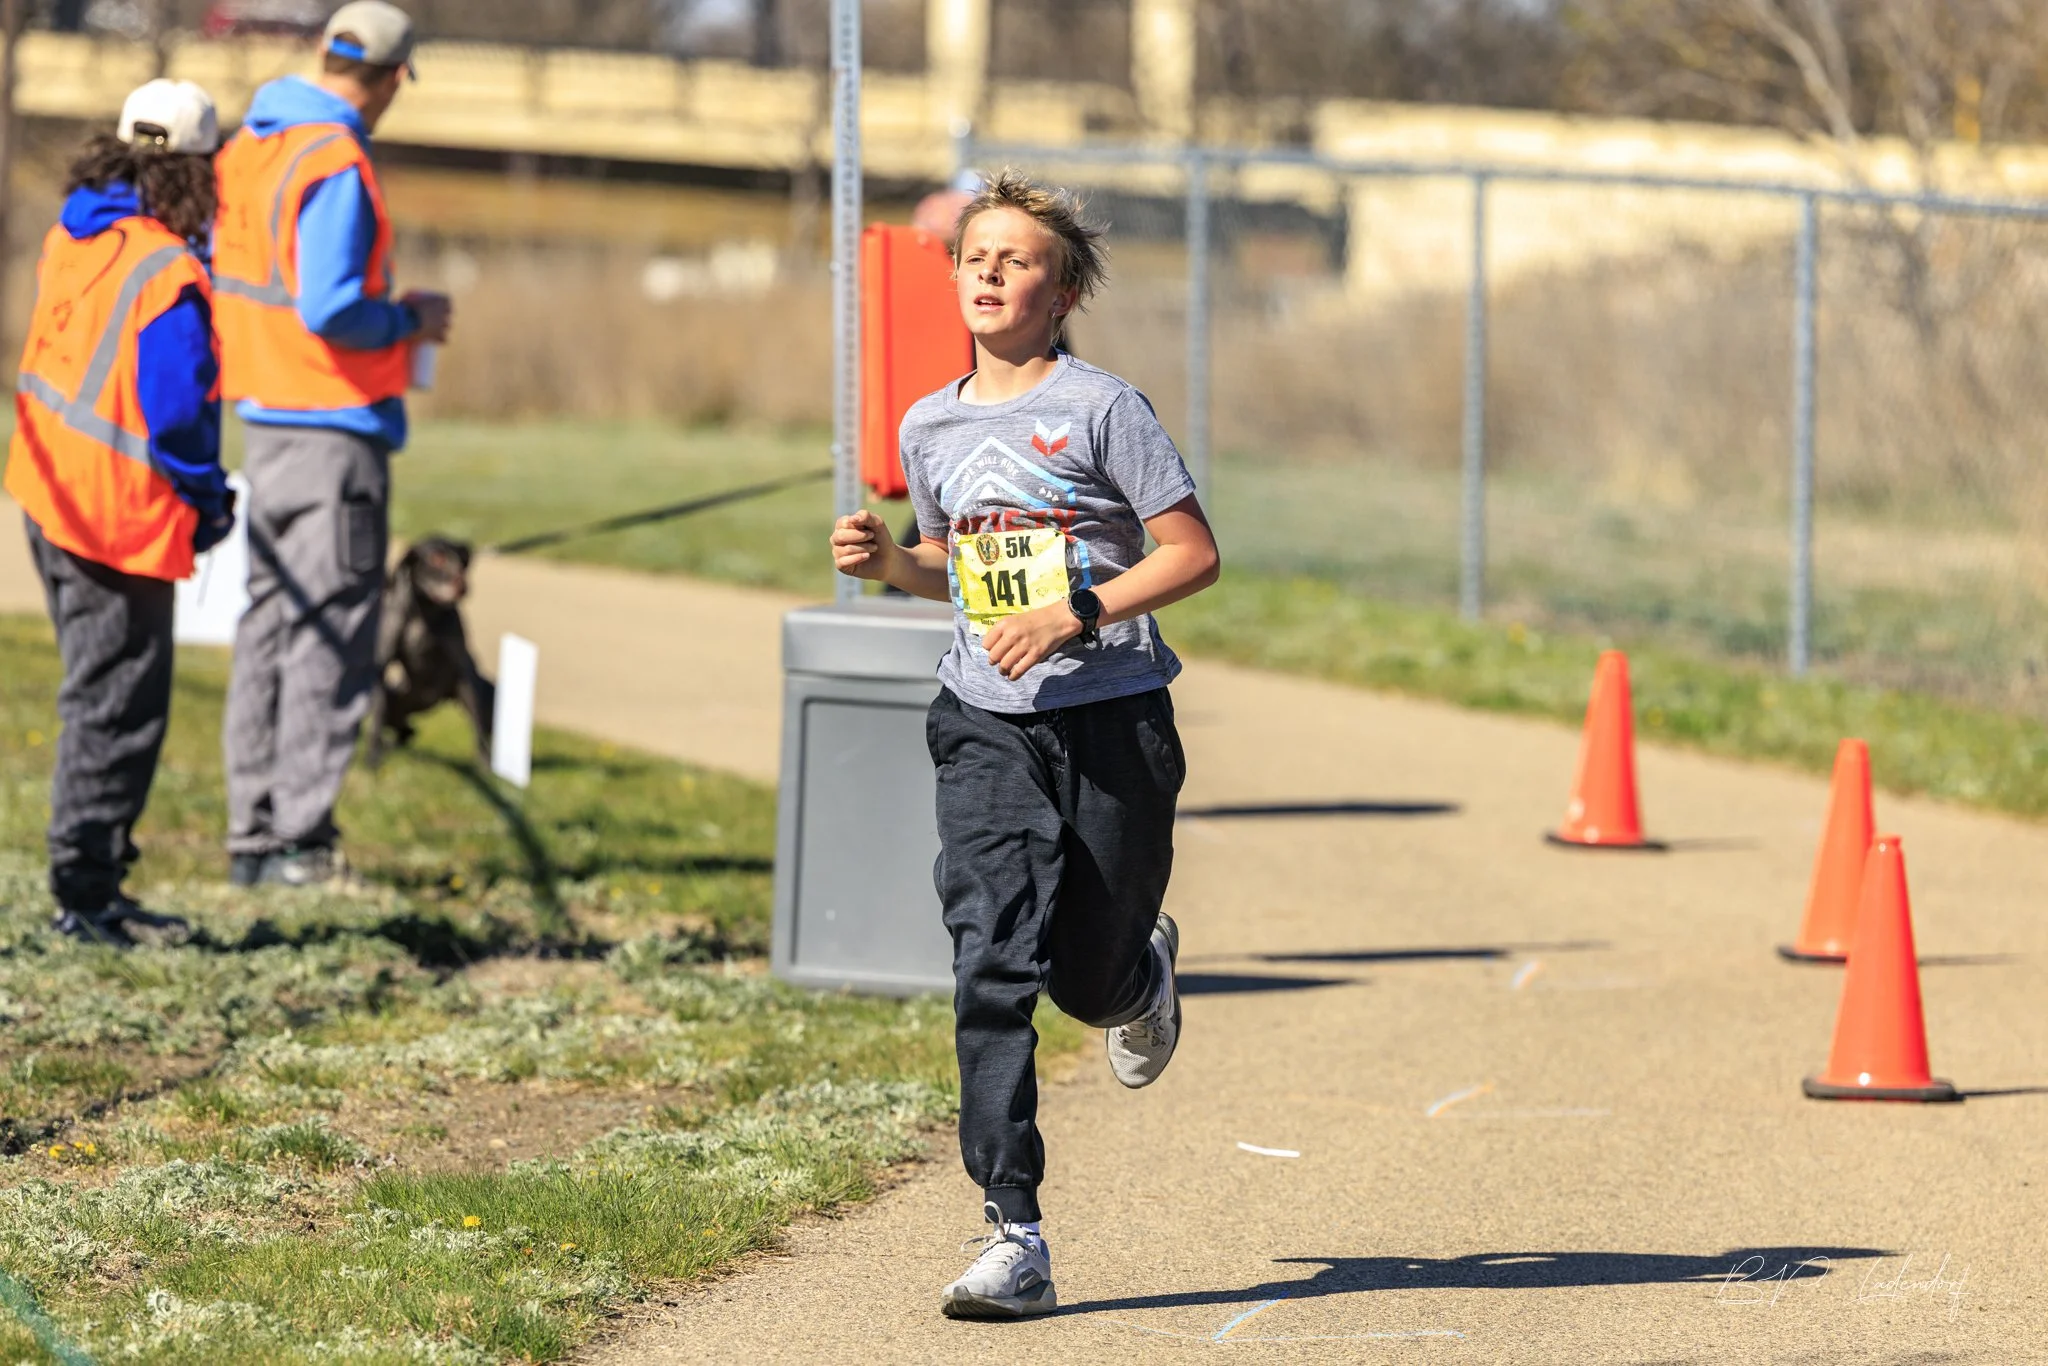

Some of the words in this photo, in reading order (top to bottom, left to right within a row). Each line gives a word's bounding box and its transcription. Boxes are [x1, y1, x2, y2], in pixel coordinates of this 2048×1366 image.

[976, 455, 999, 469] WILL
[1005, 535, 1033, 559] 5K
[980, 568, 1030, 608] 141
